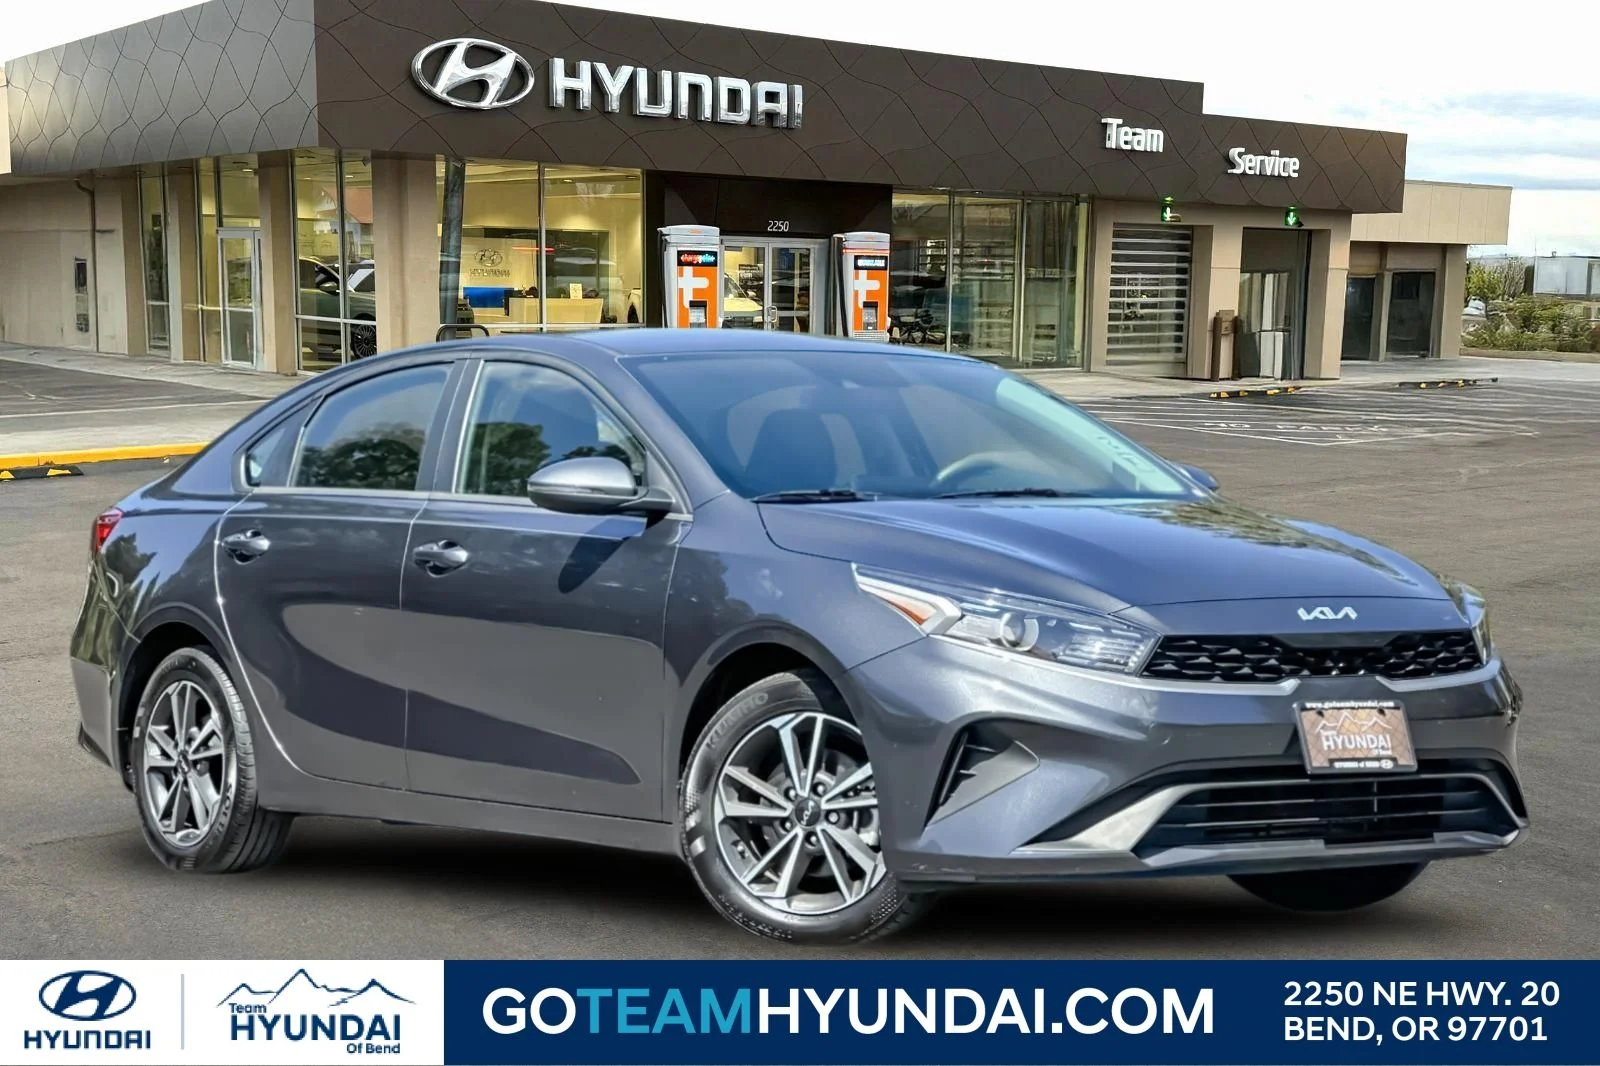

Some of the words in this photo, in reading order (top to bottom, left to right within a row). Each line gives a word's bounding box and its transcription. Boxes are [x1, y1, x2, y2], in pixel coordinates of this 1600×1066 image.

[549, 57, 804, 129] HYUNDAI
[1101, 117, 1164, 152] Team
[1227, 147, 1300, 178] Service
[767, 220, 790, 232] 2250
[1297, 606, 1358, 621] KIA
[1321, 734, 1393, 751] HYUNDAI
